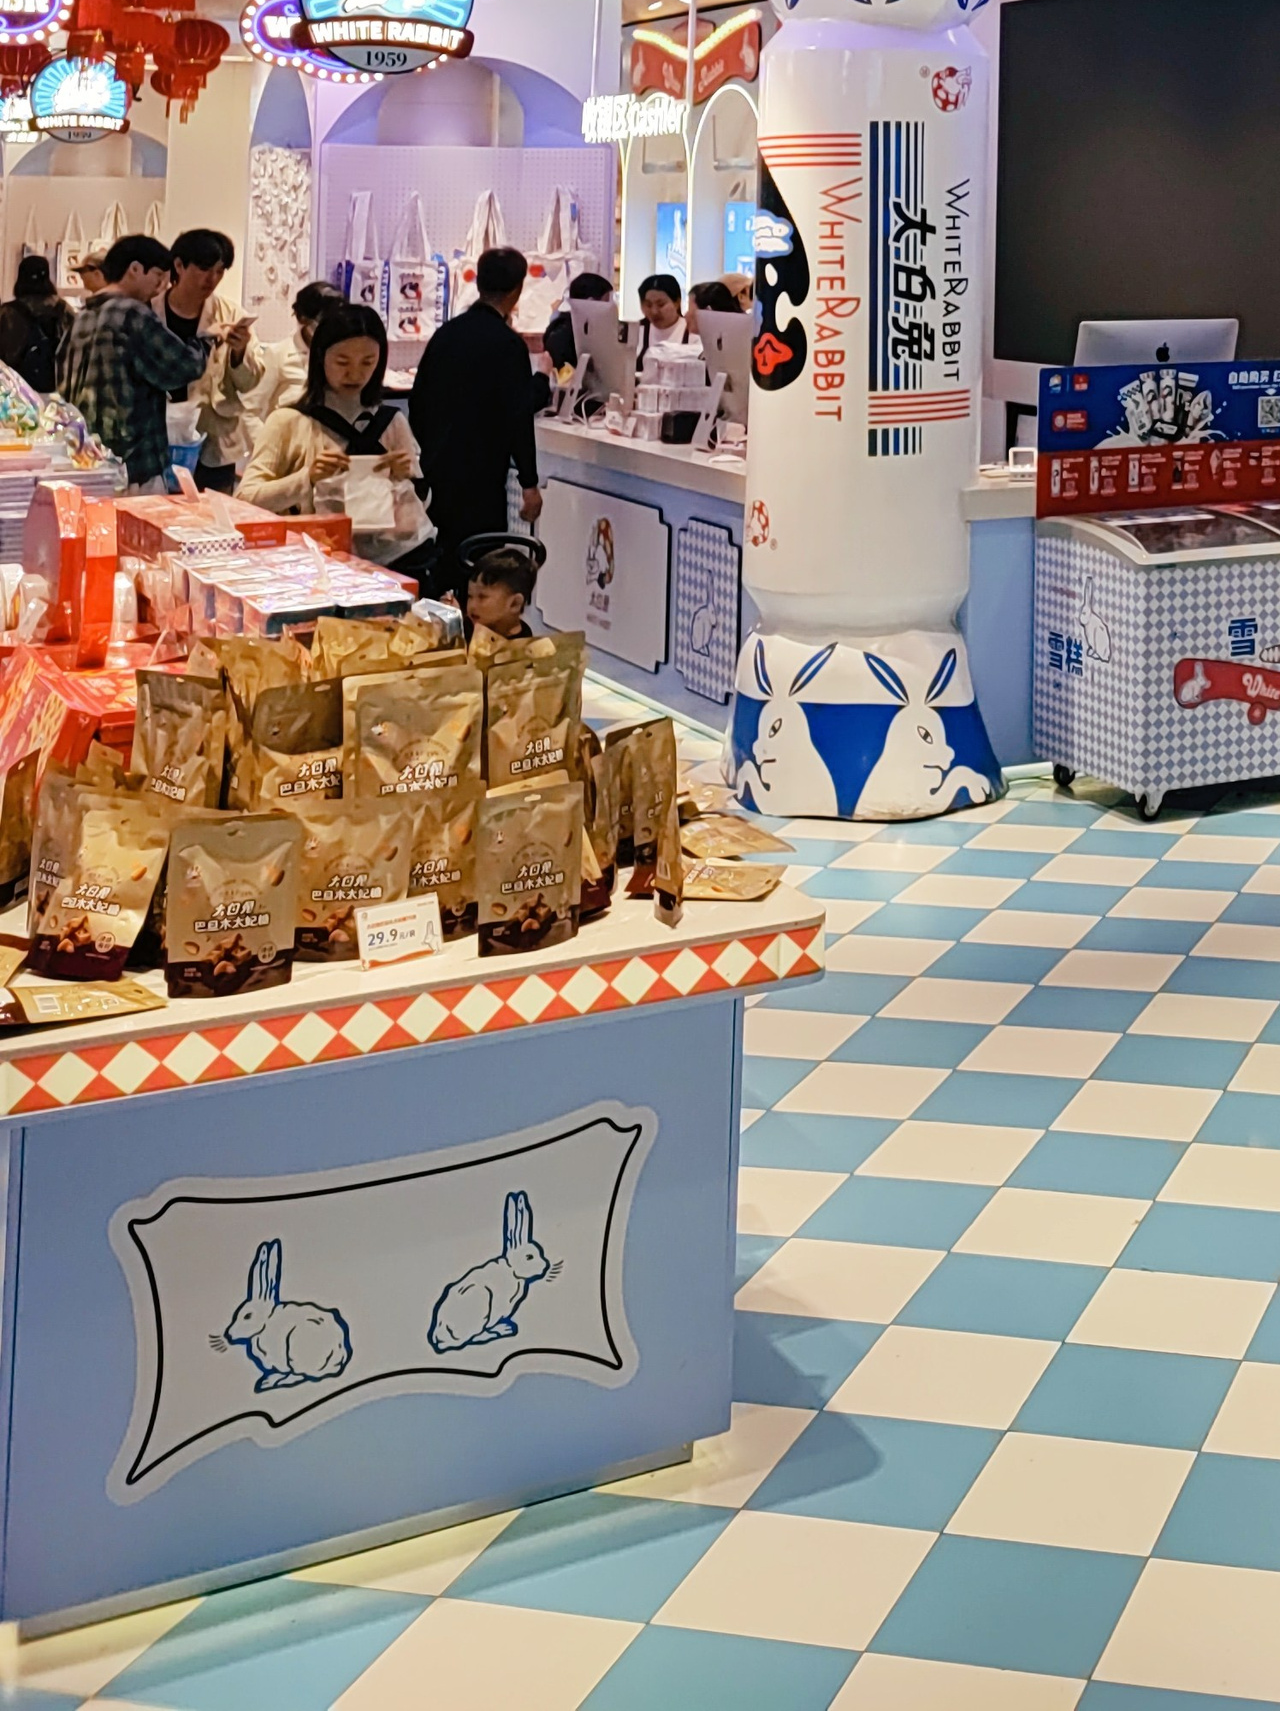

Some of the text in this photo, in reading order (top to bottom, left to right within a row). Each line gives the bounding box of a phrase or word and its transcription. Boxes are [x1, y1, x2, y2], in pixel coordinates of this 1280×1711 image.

[311, 21, 383, 44] WHITE
[387, 21, 464, 51] RABBIT
[364, 50, 407, 68] 1959
[890, 198, 936, 362] 大白兔
[1228, 371, 1269, 384] 自助购买
[1048, 631, 1083, 676] 雪糕
[1242, 673, 1280, 700] White
[298, 758, 337, 777] 大白兔
[517, 860, 553, 879] 大白兔
[327, 874, 368, 888] 大白兔
[75, 883, 111, 899] 大白兔
[212, 900, 255, 917] 大白兔
[367, 929, 398, 946] 29.9
